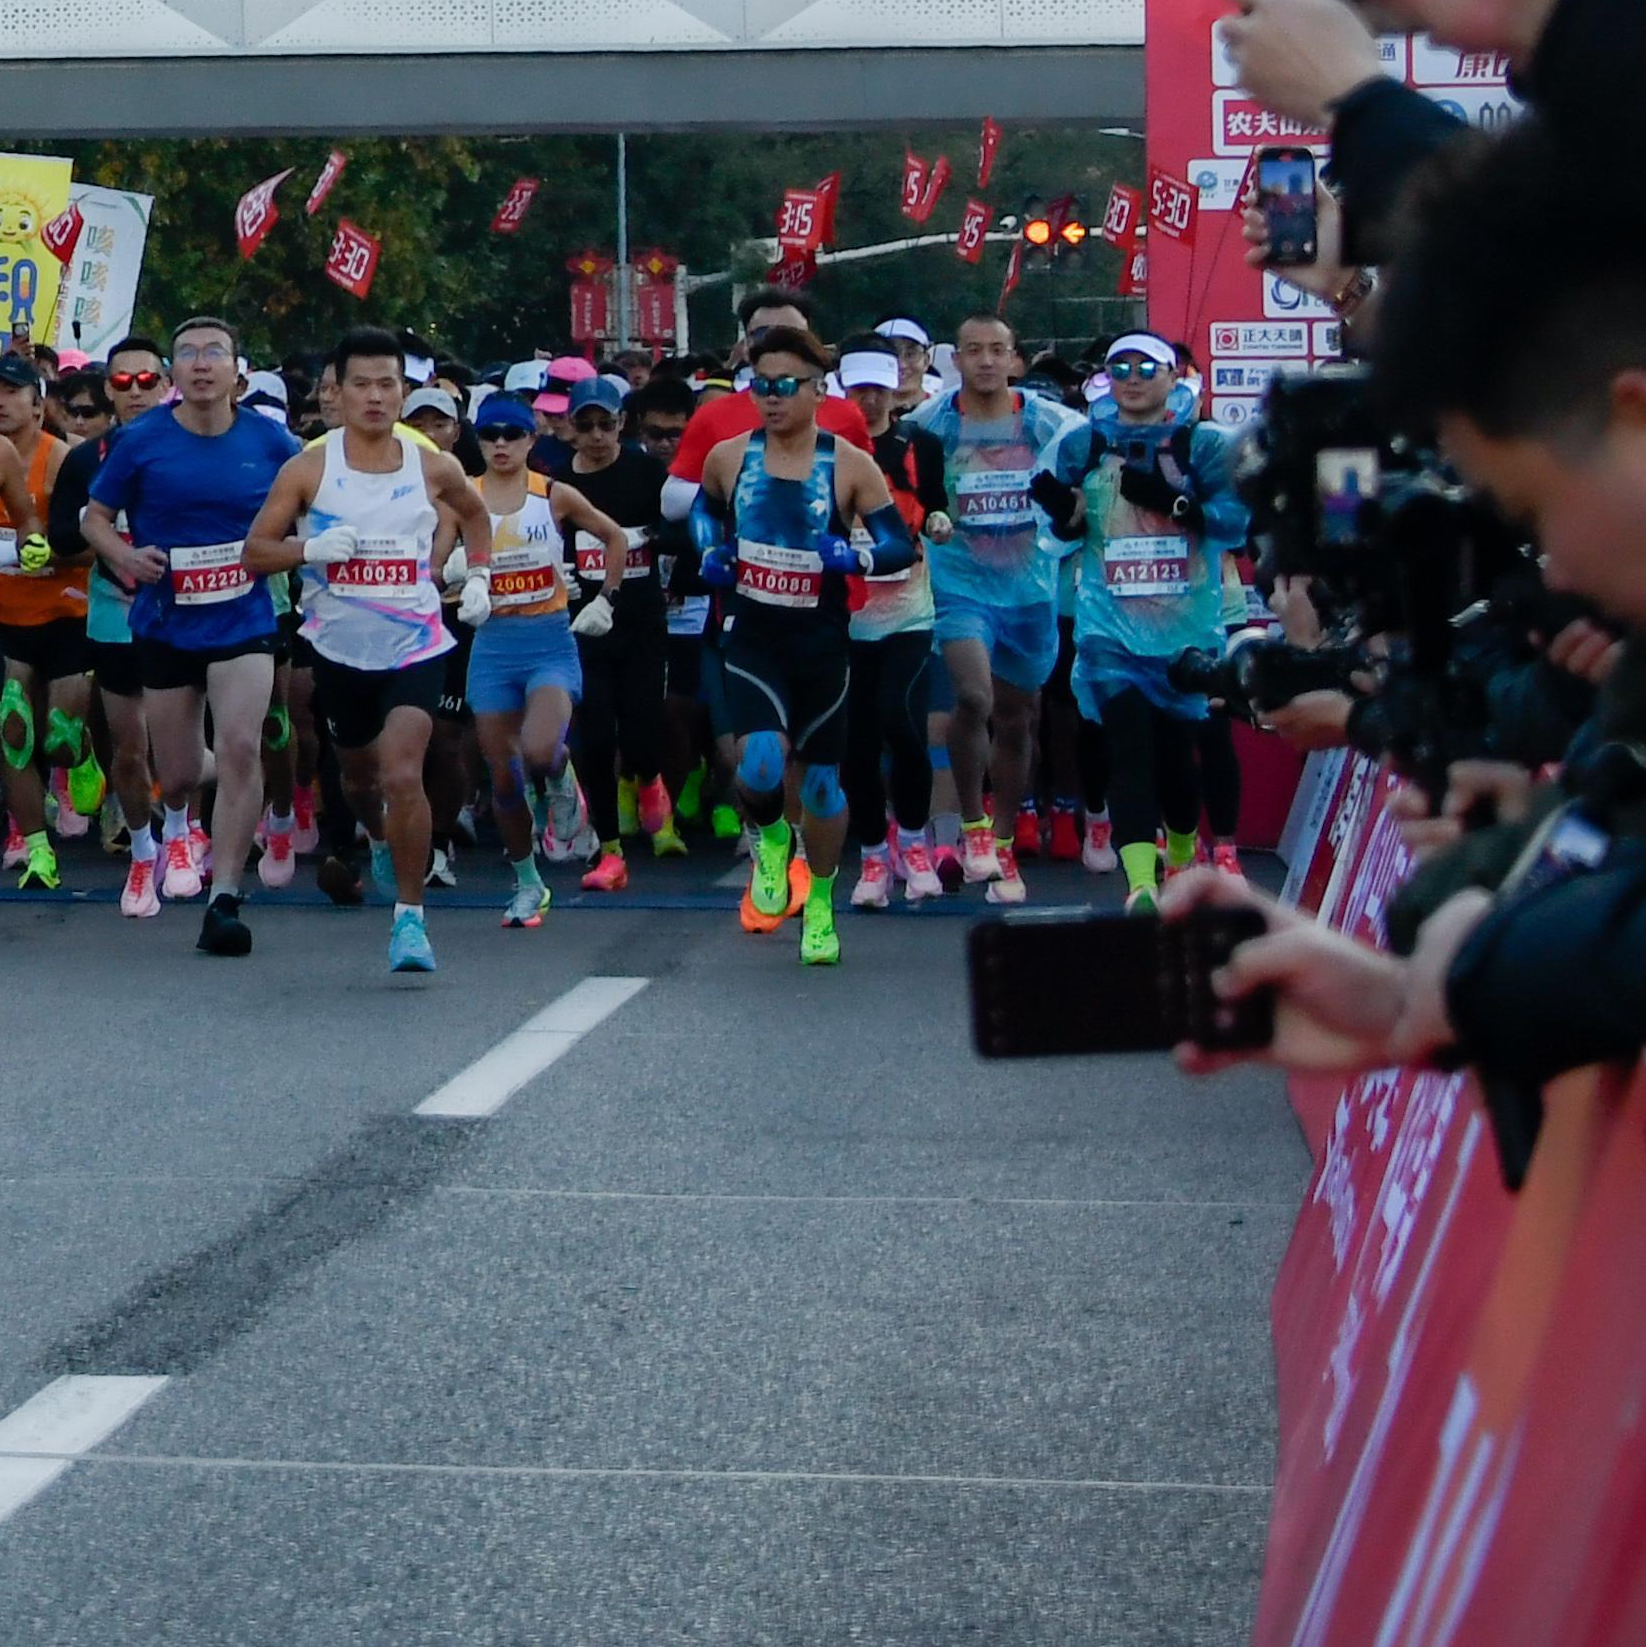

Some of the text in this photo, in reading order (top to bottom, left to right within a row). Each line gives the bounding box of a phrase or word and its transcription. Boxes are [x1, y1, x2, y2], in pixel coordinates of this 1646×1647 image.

[1151, 179, 1191, 230] 5:30
[780, 202, 813, 236] 3:15
[966, 496, 1028, 513] A10461
[584, 553, 644, 568] A115
[337, 565, 409, 582] A10033
[742, 567, 812, 593] A10088
[1113, 562, 1180, 582] A12123
[493, 574, 545, 593] 20011
